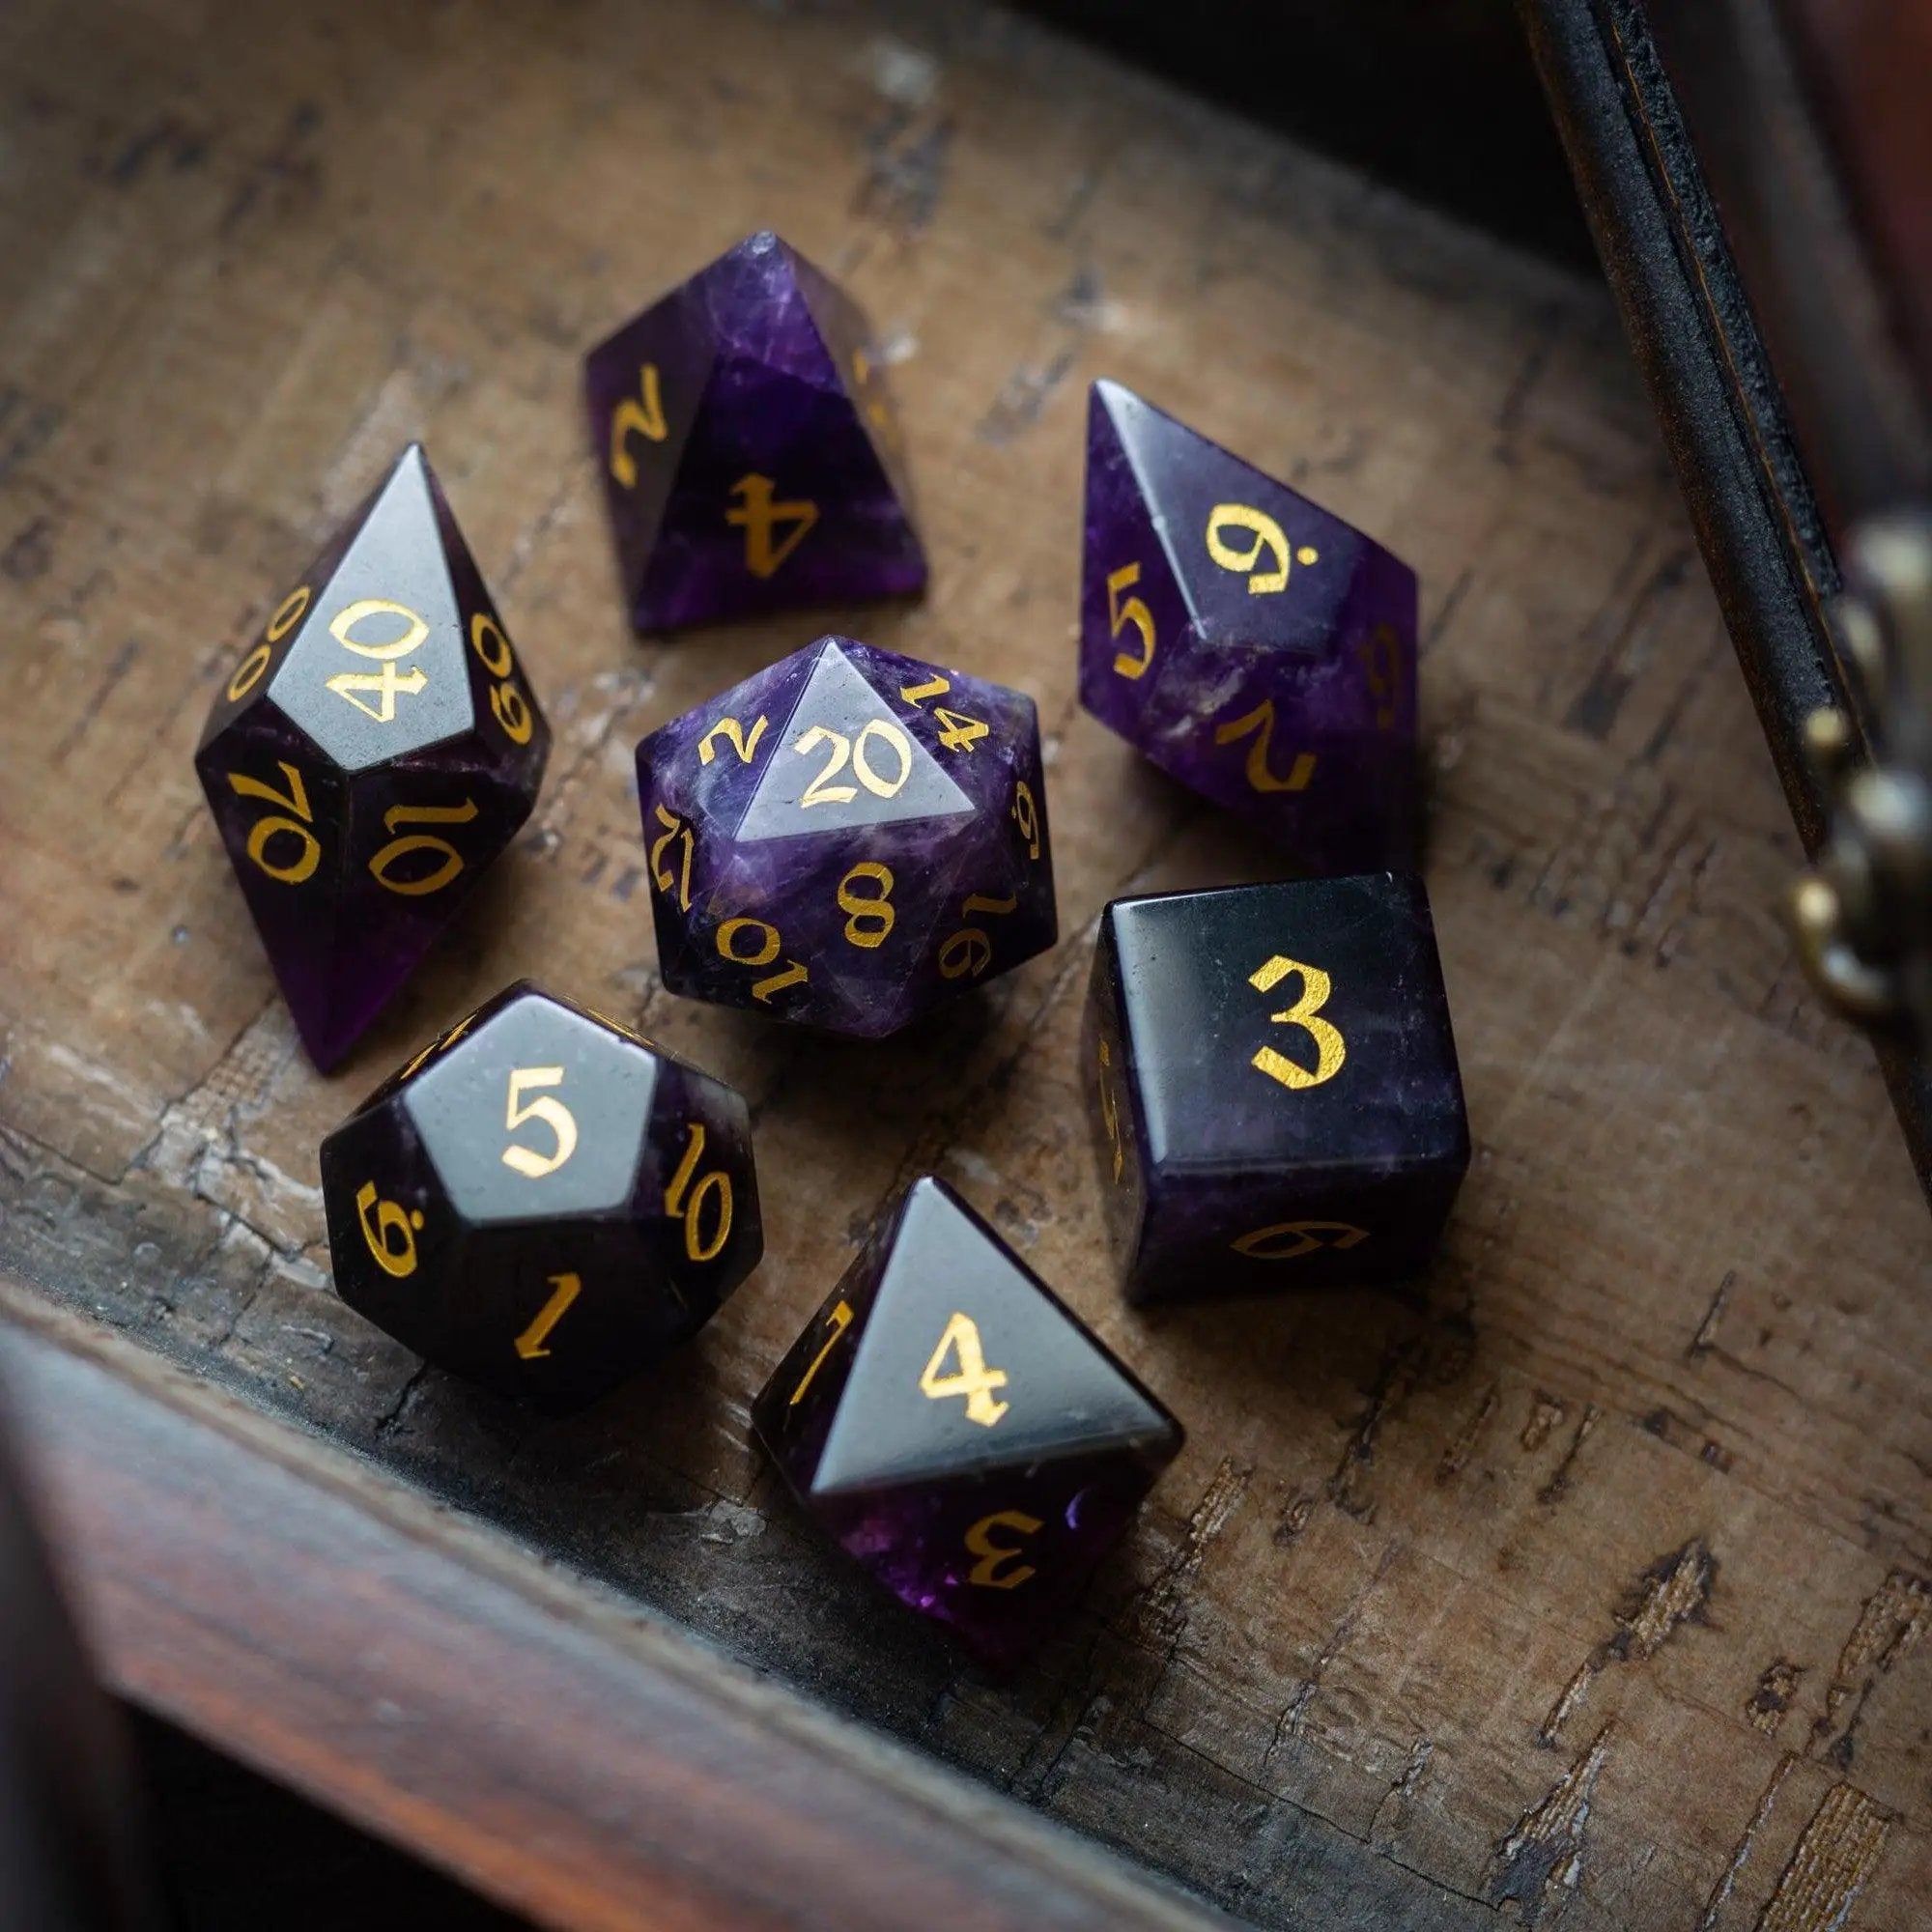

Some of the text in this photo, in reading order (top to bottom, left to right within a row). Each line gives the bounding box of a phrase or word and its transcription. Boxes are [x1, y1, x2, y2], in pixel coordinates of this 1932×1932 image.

[610, 362, 668, 488] 2
[724, 471, 819, 578] 4
[325, 598, 430, 723] 40
[1107, 560, 1155, 680] 5
[697, 715, 769, 766] 2
[794, 718, 912, 810] 20
[899, 672, 990, 753] 14
[228, 760, 321, 884] 70
[368, 796, 479, 895] 10
[650, 803, 696, 913] 12
[837, 862, 895, 949] 8
[938, 893, 1018, 980] 16
[715, 917, 809, 1005] 10
[1247, 954, 1346, 1091] 3
[501, 1065, 578, 1179] 5
[664, 1123, 733, 1262] 10
[514, 1271, 582, 1359] 1
[920, 1312, 1009, 1428] 4
[964, 1510, 1044, 1590] 3
